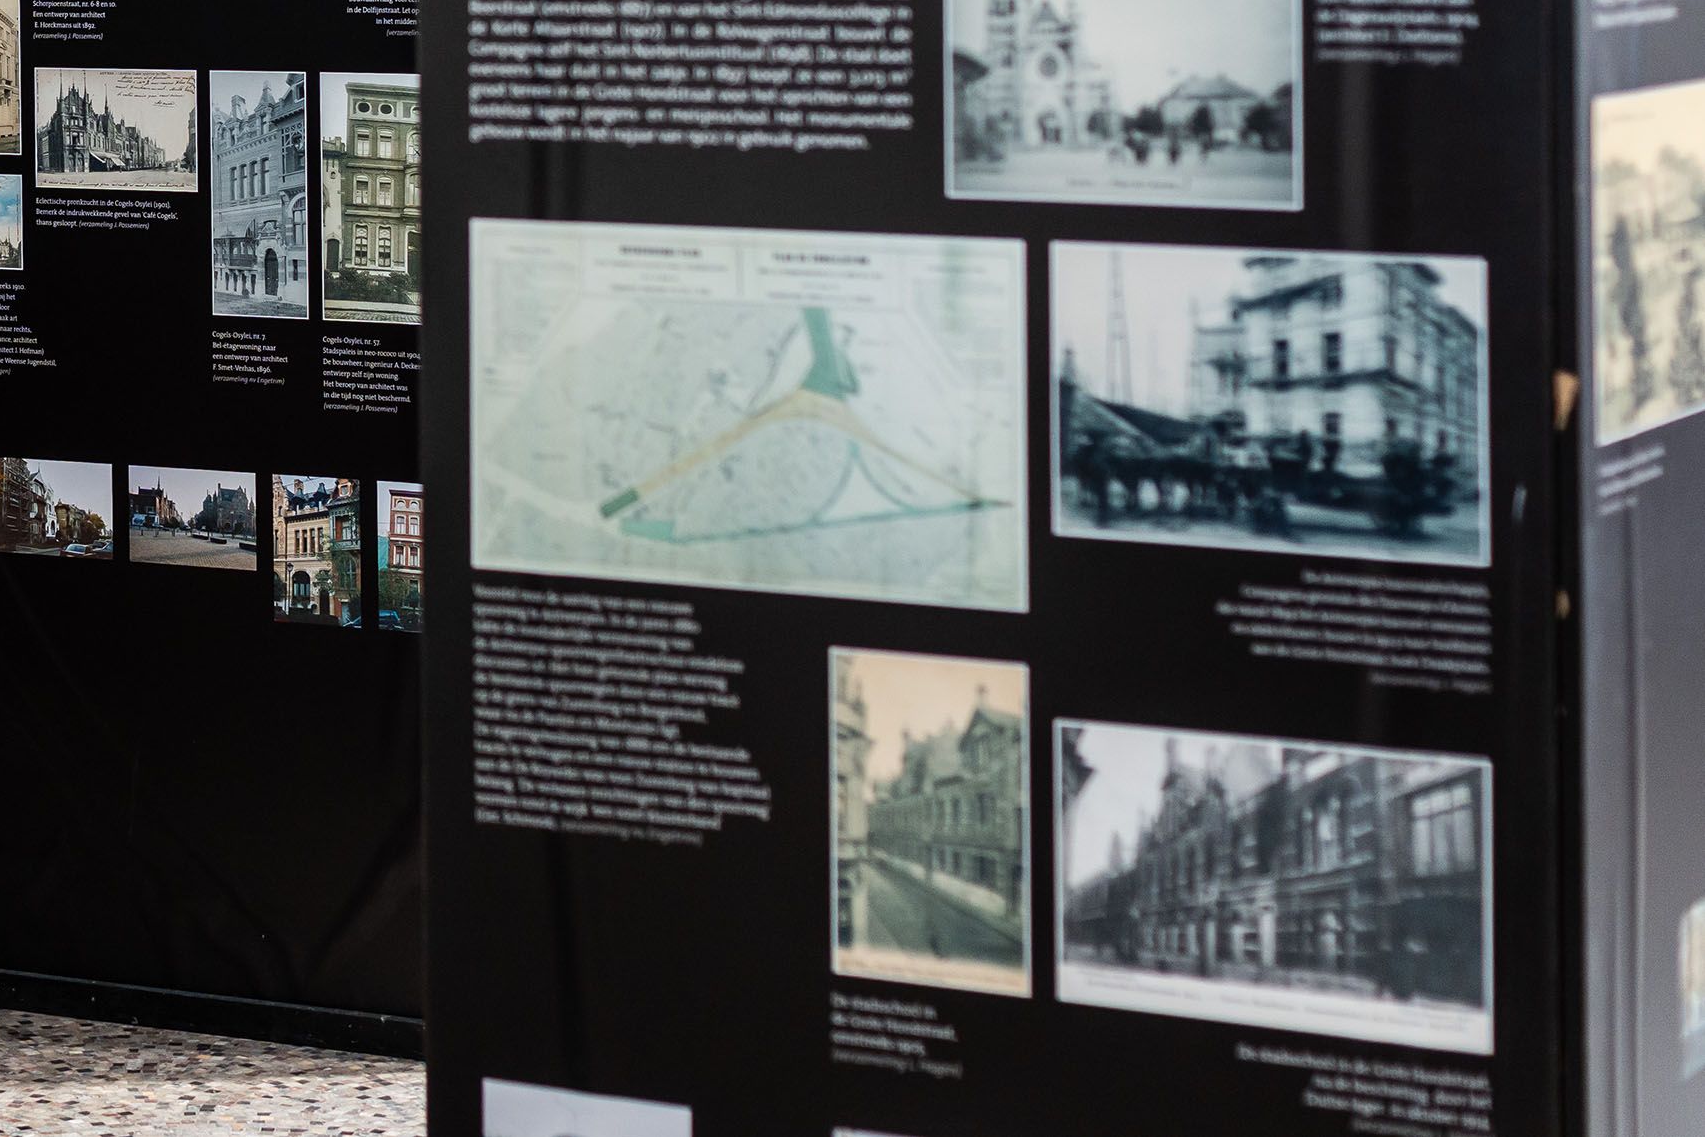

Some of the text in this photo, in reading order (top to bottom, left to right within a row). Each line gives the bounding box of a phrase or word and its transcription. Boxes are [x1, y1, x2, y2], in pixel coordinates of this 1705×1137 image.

[43, 11, 68, 19] ontwerp
[35, 207, 57, 215] Bemerk
[66, 208, 113, 217] indrukwekkende
[113, 210, 129, 219] gevel
[223, 353, 249, 362] ontwerp
[262, 355, 288, 363] architect
[323, 379, 334, 387] Het
[335, 380, 356, 390] beroep
[368, 382, 395, 391] architect
